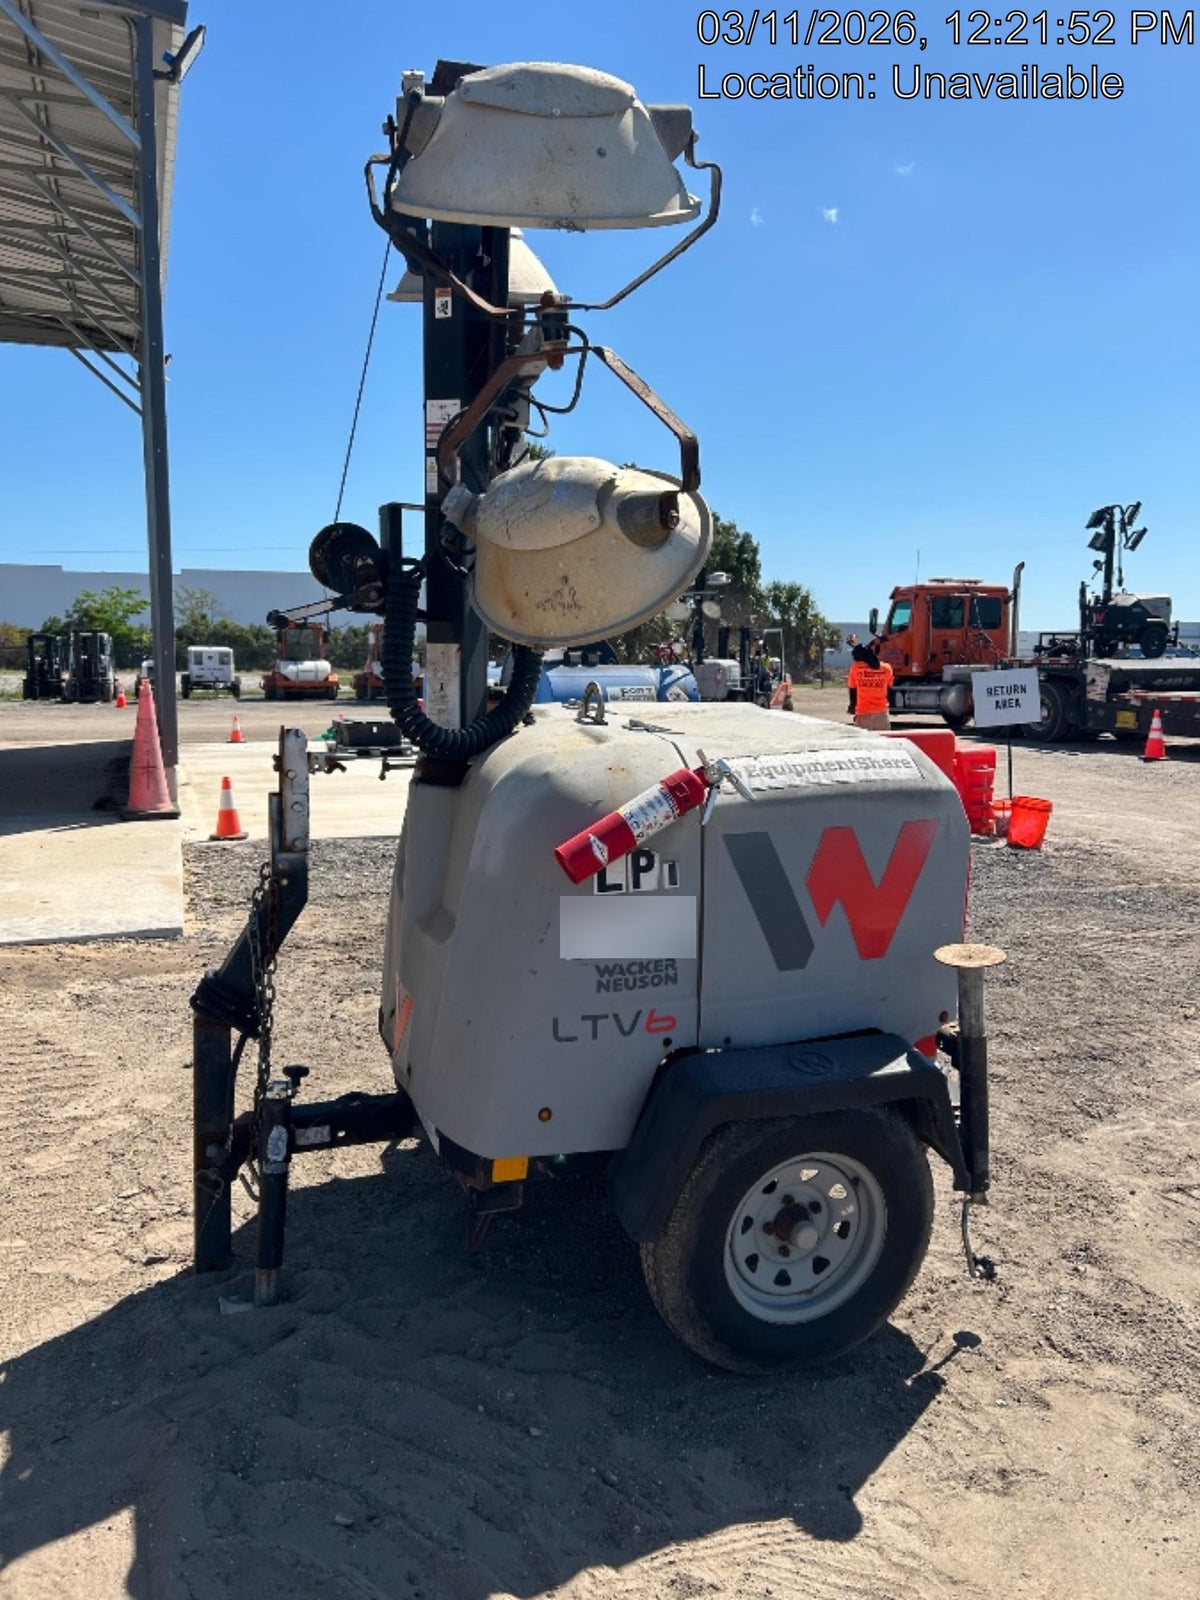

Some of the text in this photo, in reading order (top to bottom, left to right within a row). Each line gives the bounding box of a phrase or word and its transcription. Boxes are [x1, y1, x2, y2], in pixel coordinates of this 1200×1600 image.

[986, 684, 1027, 697] RETURN
[995, 698, 1021, 710] AREA
[746, 757, 913, 780] EquipmentShare
[594, 958, 677, 979] WACKER
[595, 971, 678, 994] NEUSON
[552, 1008, 677, 1043] LTV6
